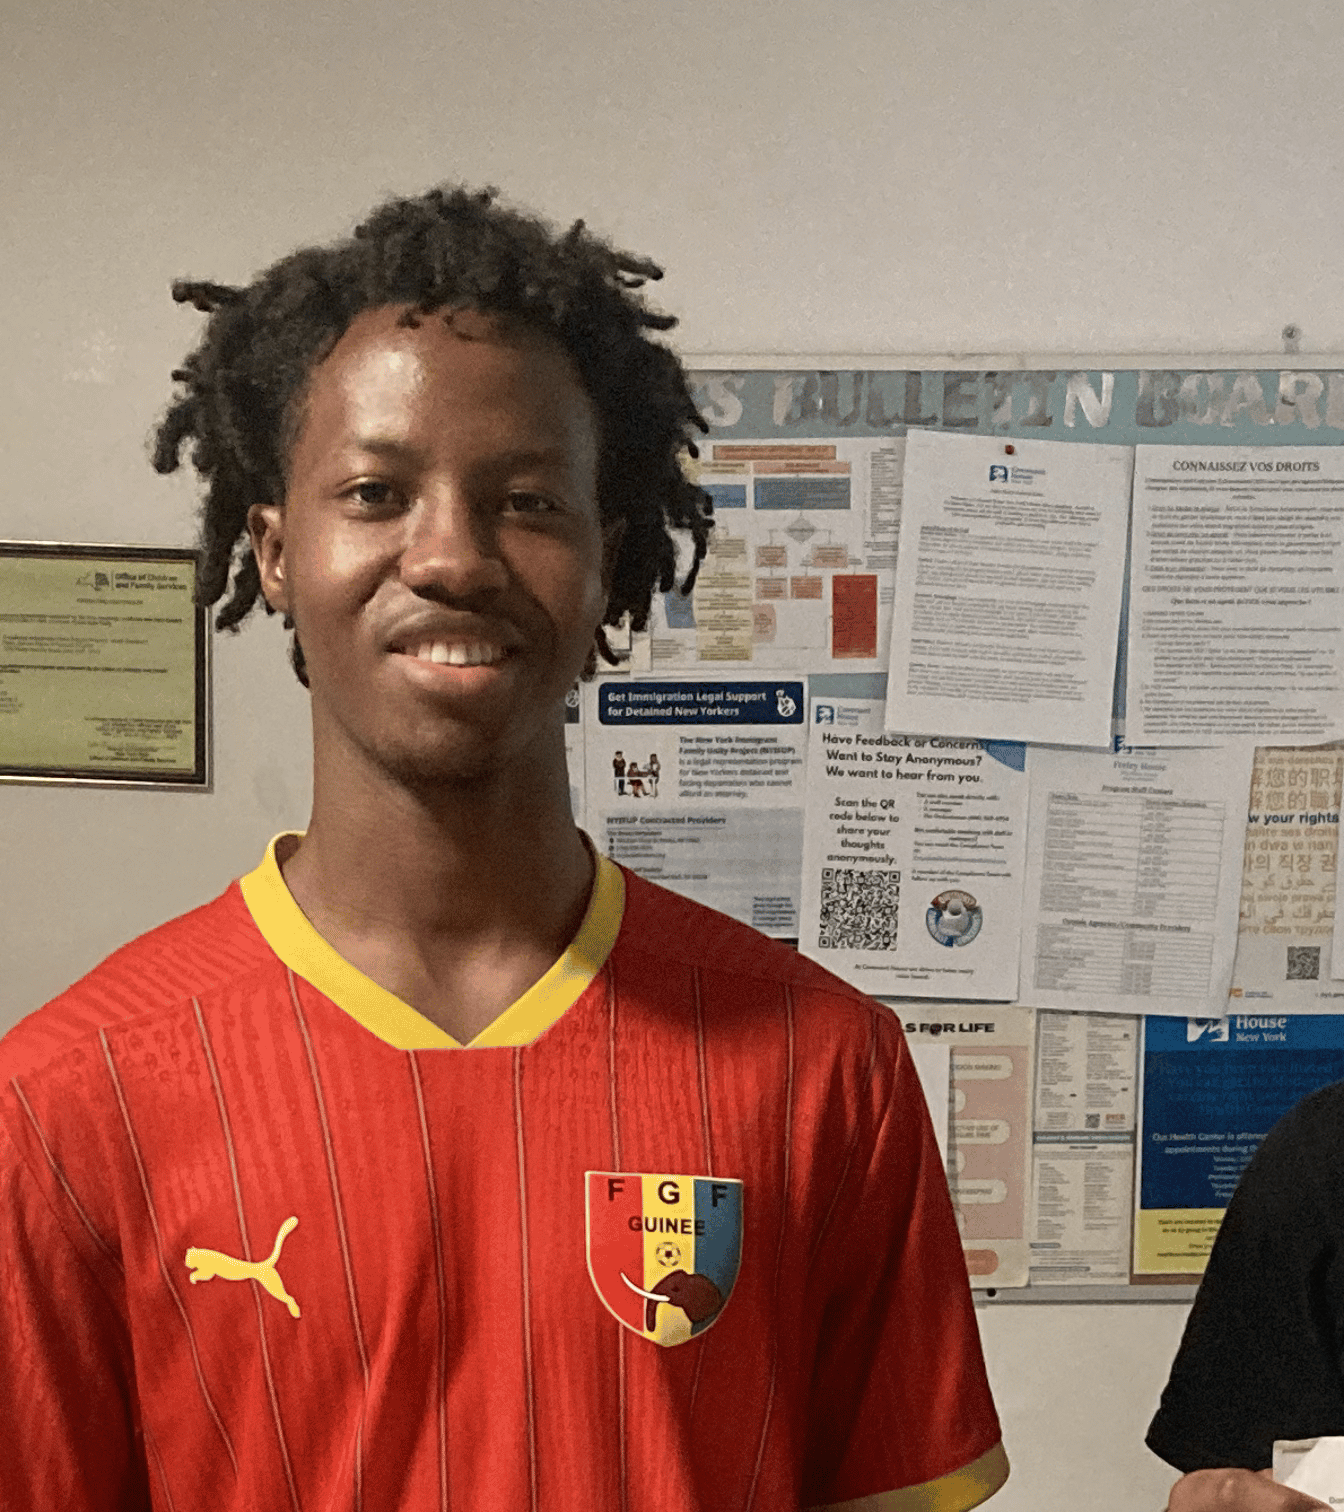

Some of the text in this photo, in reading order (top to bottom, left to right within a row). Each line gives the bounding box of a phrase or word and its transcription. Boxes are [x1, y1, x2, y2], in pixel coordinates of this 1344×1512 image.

[772, 370, 1114, 428] BULLETIN
[1172, 461, 1320, 472] CONNAISSEZ VOS DROITS
[608, 691, 767, 704] Get Immigration Legal Support
[608, 706, 740, 717] for Detained New Yorkers
[822, 733, 853, 745] Have
[855, 734, 910, 748] Feedback
[914, 739, 925, 749] or
[826, 750, 983, 769] Want to Stay Anonymous?
[825, 766, 844, 778] We
[847, 768, 878, 780] want
[881, 769, 893, 780] to
[896, 769, 924, 780] hear
[926, 770, 955, 782] from
[835, 797, 895, 810] Scan the QR
[640, 816, 685, 824] Contracted
[687, 816, 726, 824] Providers
[829, 811, 900, 823] code below to
[1264, 811, 1340, 826] your rights
[837, 824, 891, 838] share your
[841, 838, 885, 851] thoughts
[826, 854, 898, 866] anonymously.
[959, 1022, 995, 1033] LIFE
[1236, 1015, 1287, 1030] House
[1236, 1031, 1287, 1043] New York
[608, 1178, 728, 1208] F G F
[627, 1215, 706, 1237] GUINEE
